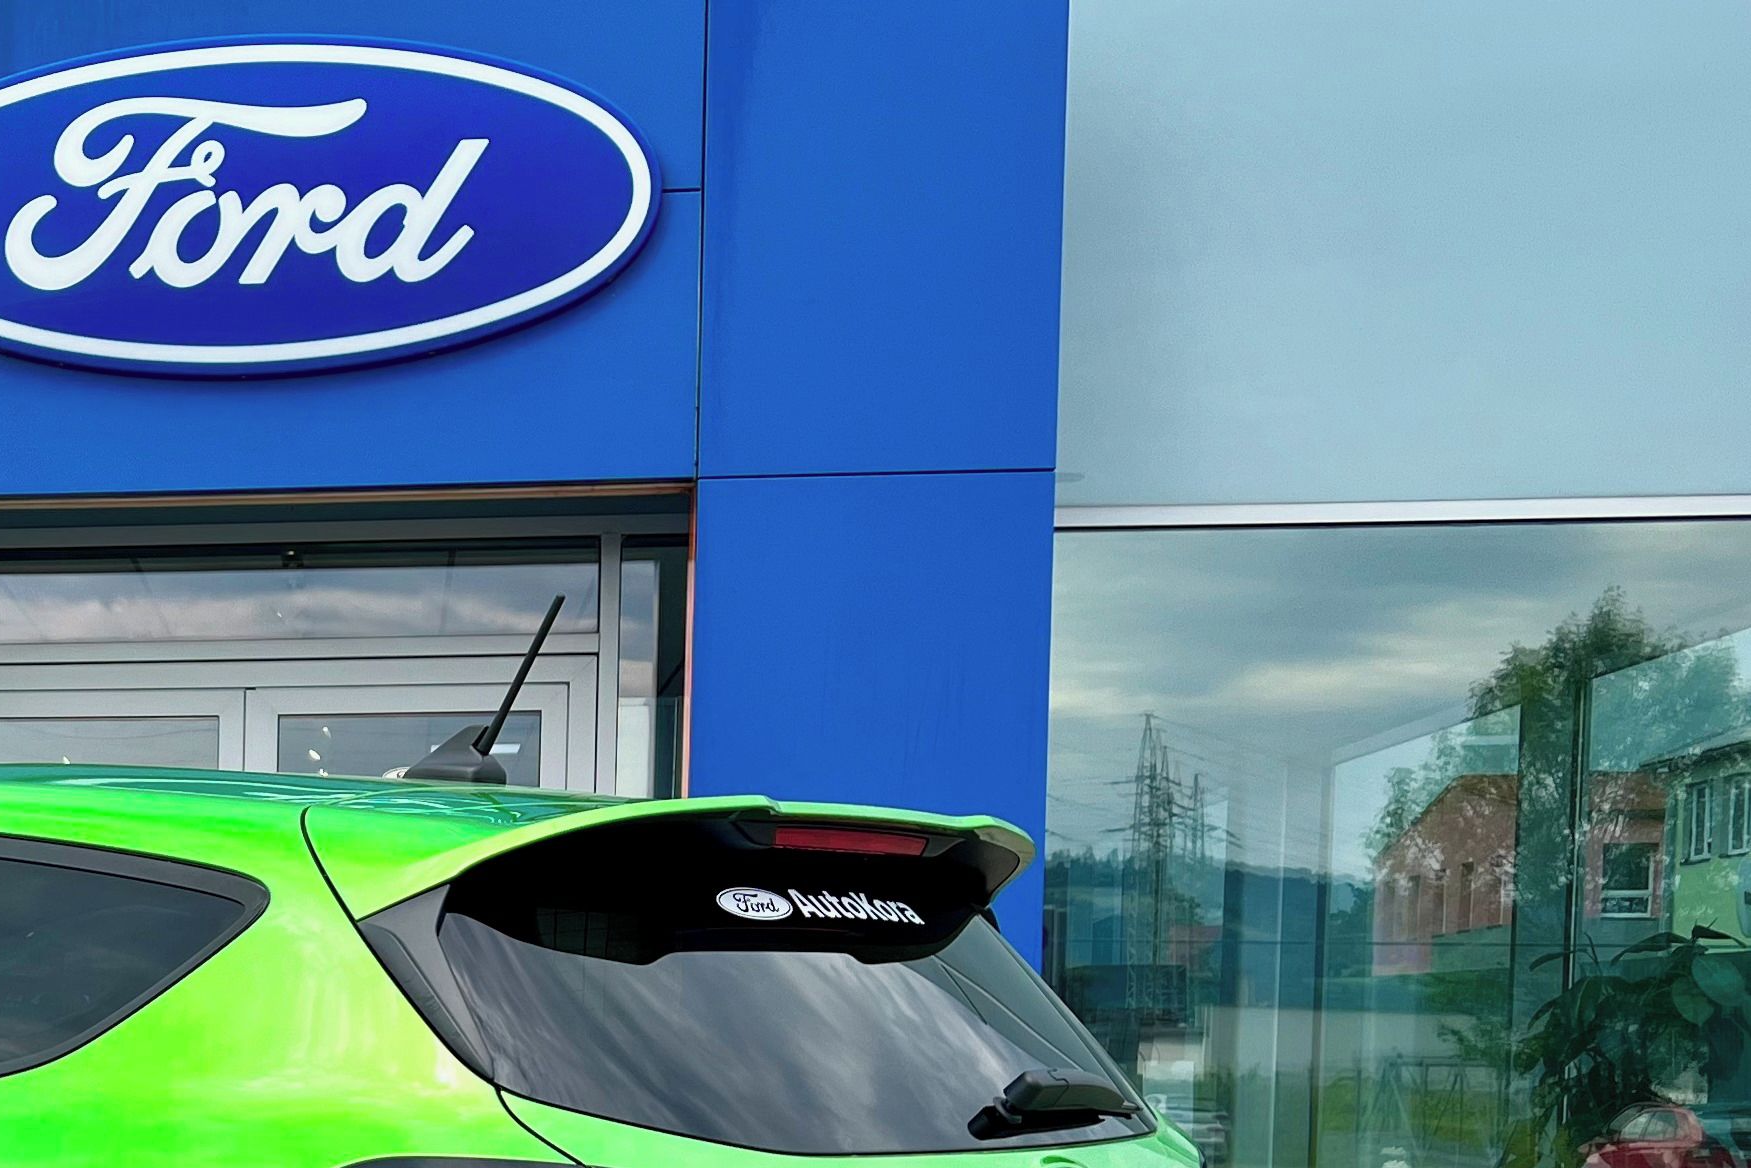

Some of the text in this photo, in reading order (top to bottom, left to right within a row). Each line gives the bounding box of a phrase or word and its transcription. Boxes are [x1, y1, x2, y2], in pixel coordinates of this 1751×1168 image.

[5, 96, 490, 291] Ford
[733, 892, 780, 913] Ford
[788, 889, 925, 925] AutoKora
